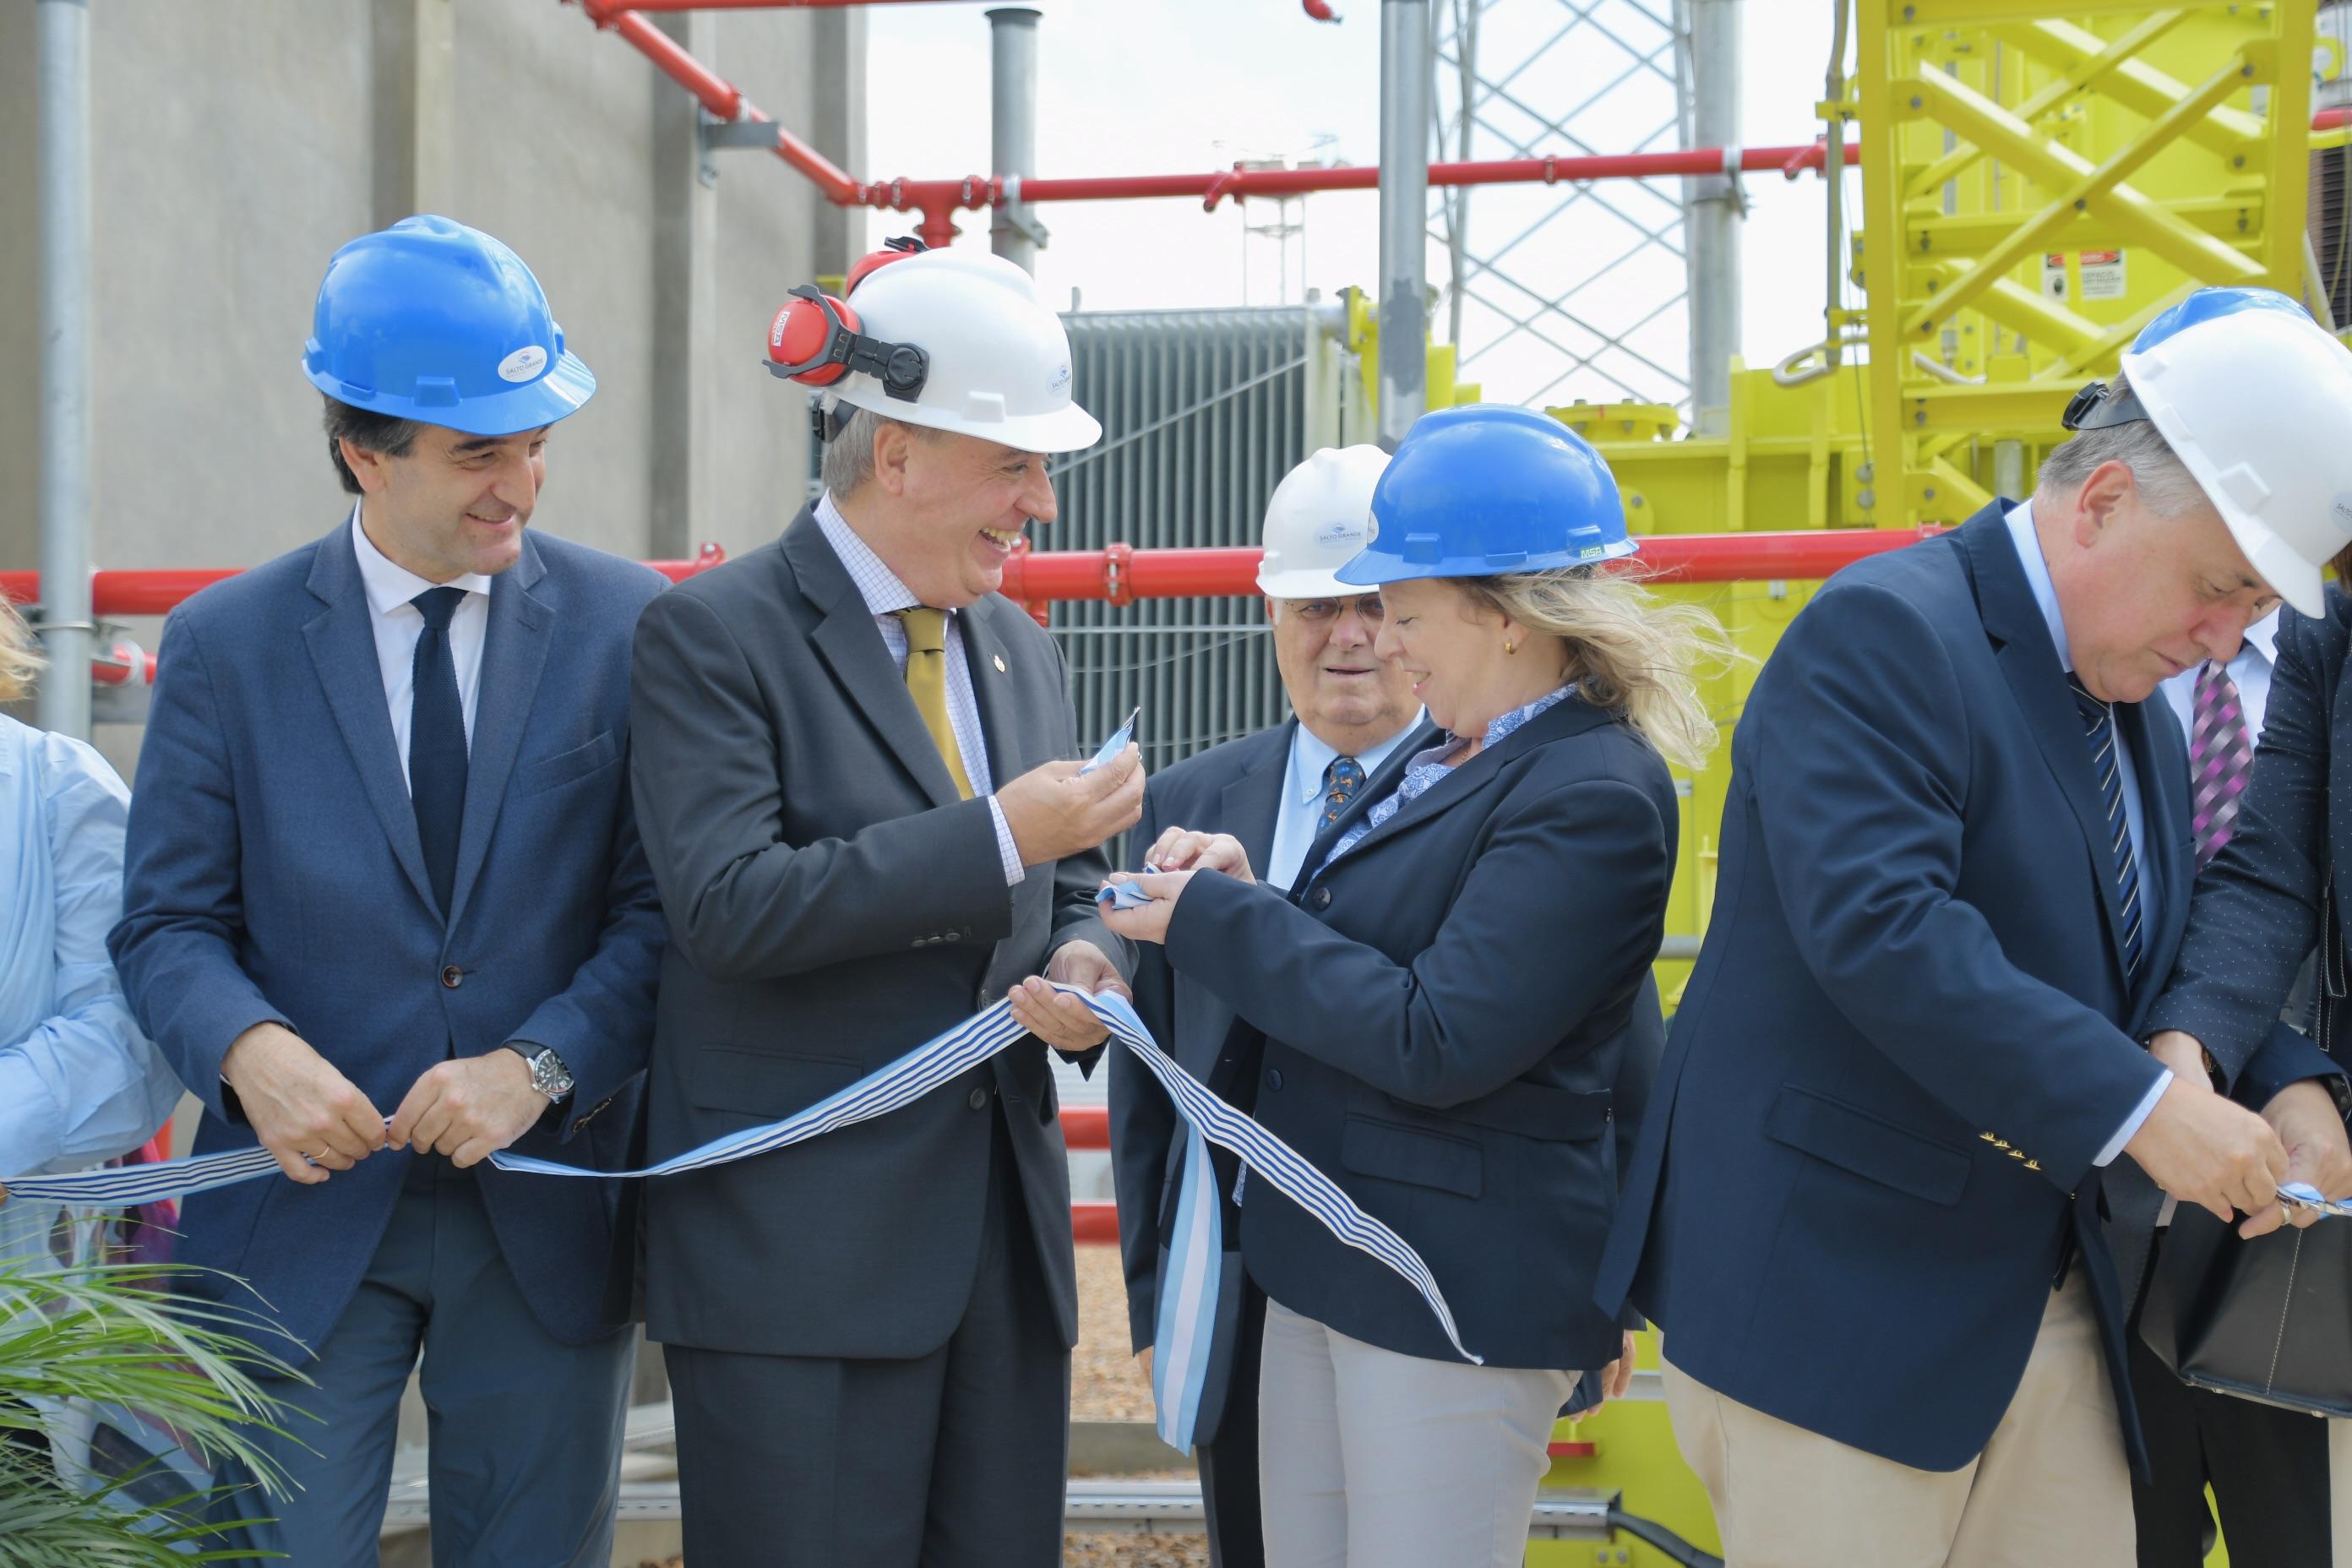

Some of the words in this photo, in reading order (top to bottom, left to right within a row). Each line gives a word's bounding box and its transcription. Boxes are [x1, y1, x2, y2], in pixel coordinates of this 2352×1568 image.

[775, 313, 788, 344] MSA
[506, 365, 524, 373] SALTO
[1581, 547, 1602, 558] MSA
